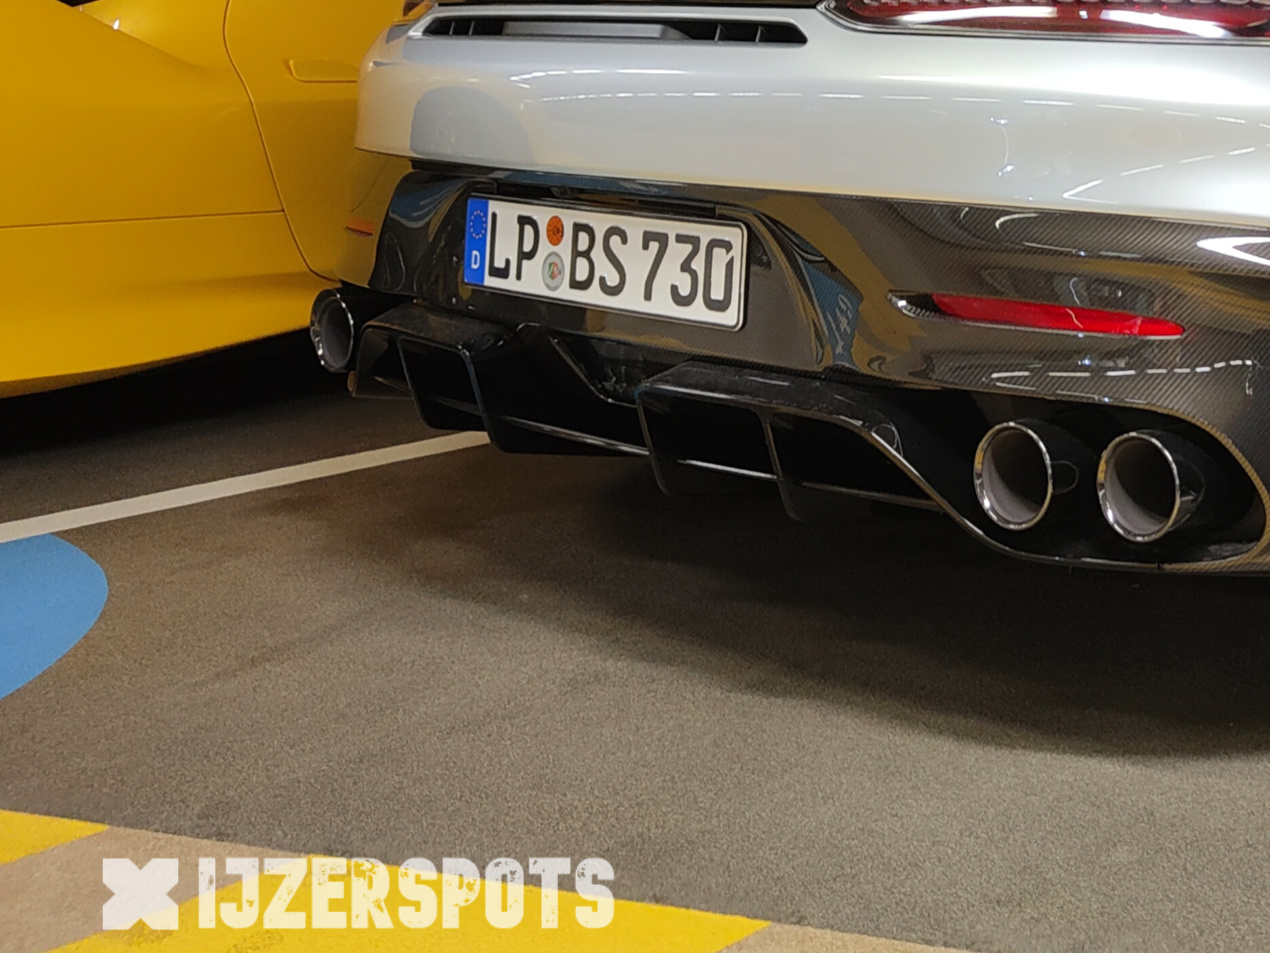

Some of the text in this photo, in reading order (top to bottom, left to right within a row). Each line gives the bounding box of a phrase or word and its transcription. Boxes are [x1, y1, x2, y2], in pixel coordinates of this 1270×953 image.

[470, 250, 480, 269] D
[488, 211, 734, 313] LP BS 730
